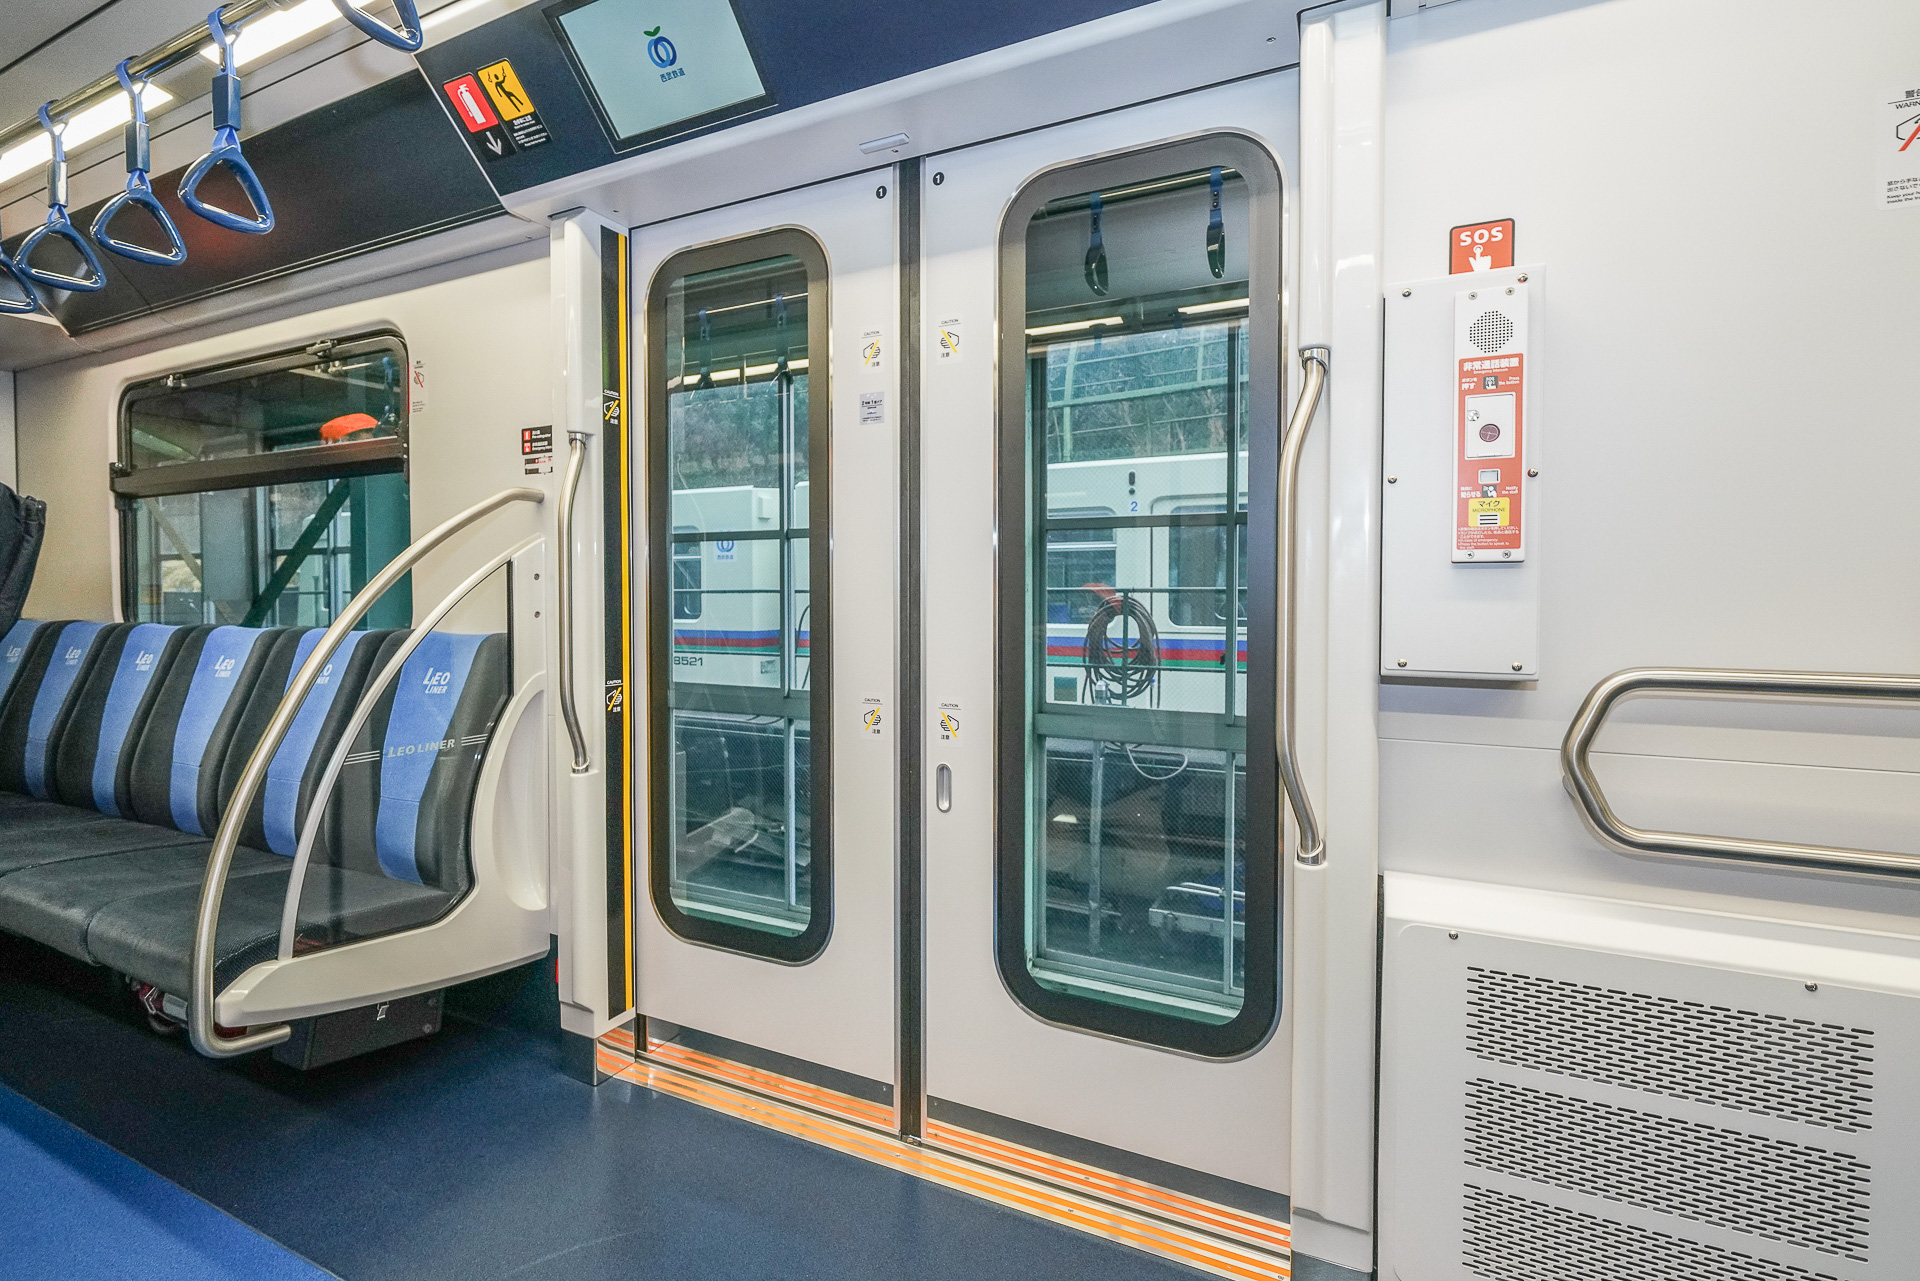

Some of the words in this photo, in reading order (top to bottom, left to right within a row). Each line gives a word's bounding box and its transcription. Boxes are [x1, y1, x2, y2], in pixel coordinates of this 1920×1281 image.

[660, 68, 686, 82] 西武鉄道
[1460, 226, 1503, 246] SOS
[1131, 501, 1138, 512] 2
[65, 646, 82, 659] LEO
[135, 651, 153, 664] LEO
[214, 655, 235, 670] LEO
[674, 656, 703, 667] 8521
[423, 667, 451, 685] LEO
[425, 684, 448, 694] LINER
[387, 744, 415, 758] LEO
[417, 739, 455, 754] LINER
